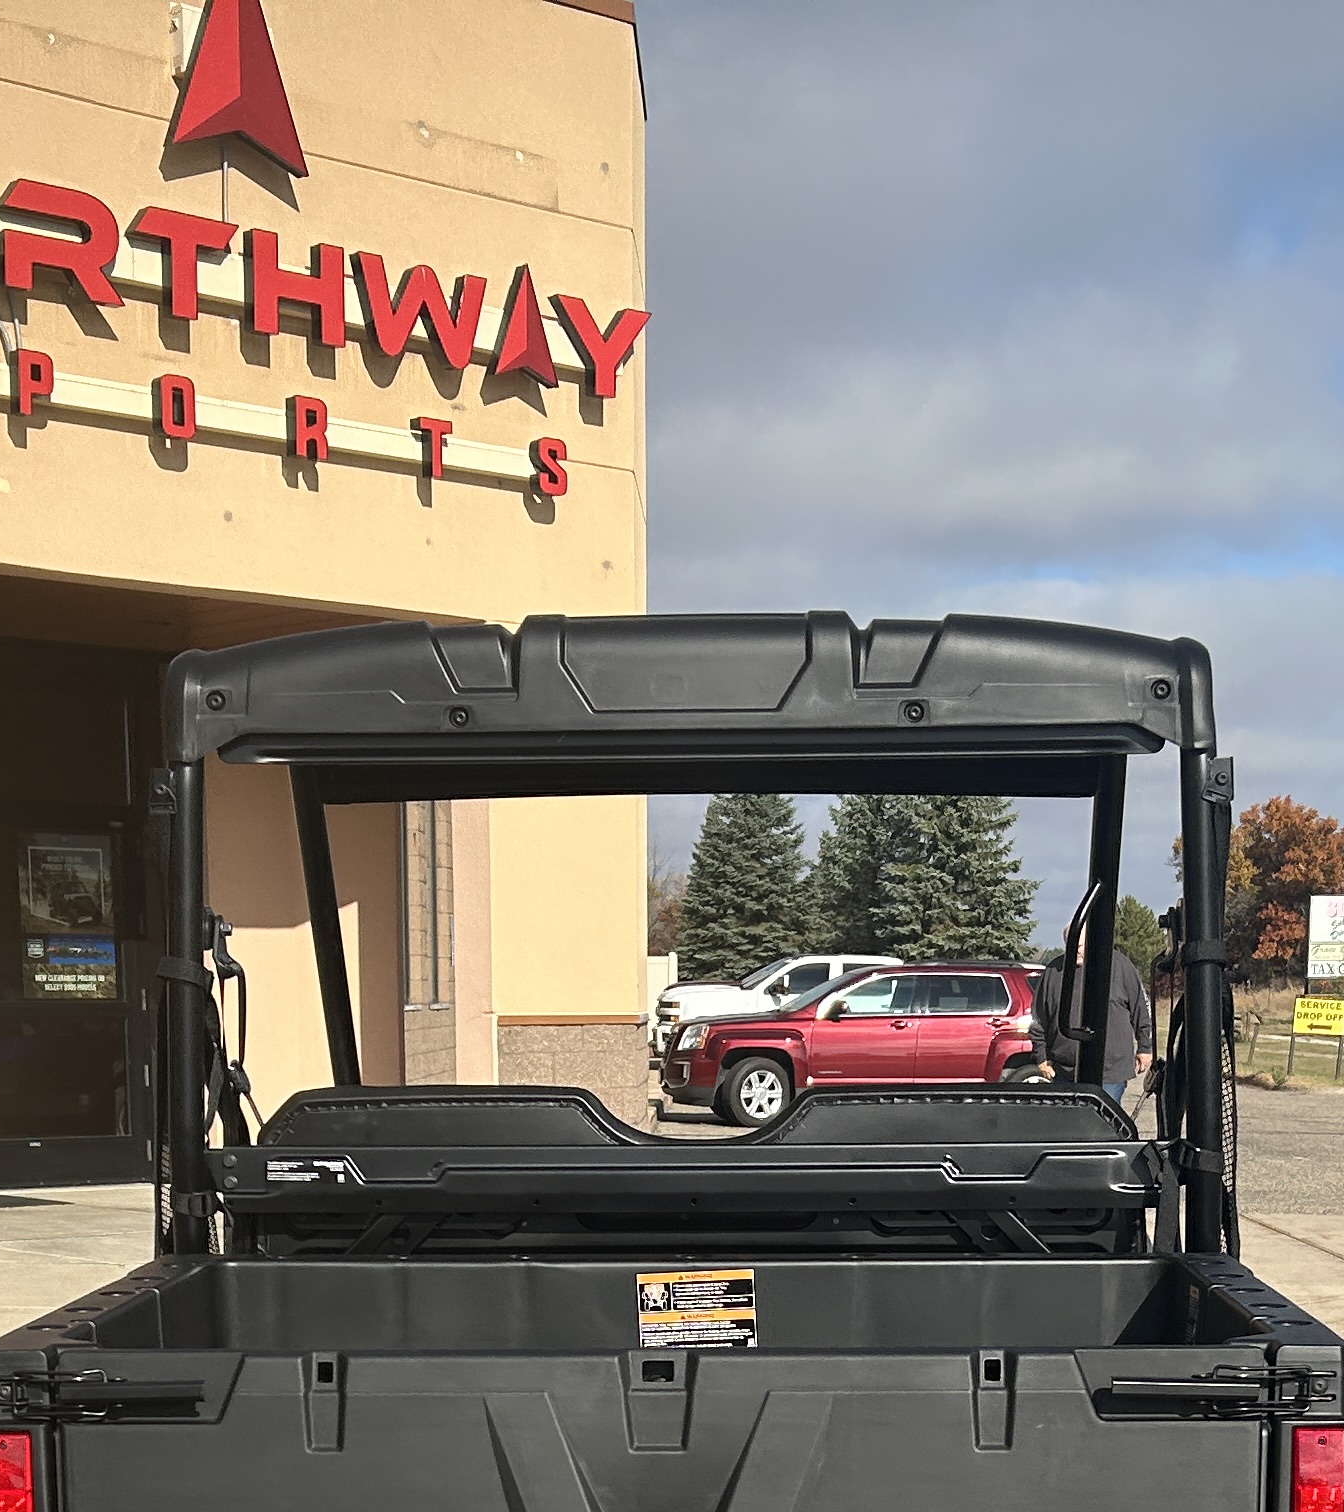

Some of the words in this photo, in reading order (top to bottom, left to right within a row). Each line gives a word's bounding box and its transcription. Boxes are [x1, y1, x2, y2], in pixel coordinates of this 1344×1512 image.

[1311, 963, 1335, 975] TAX
[1300, 1000, 1342, 1010] SERVICE
[1296, 1012, 1323, 1021] DROP
[1326, 1013, 1344, 1021] OFF
